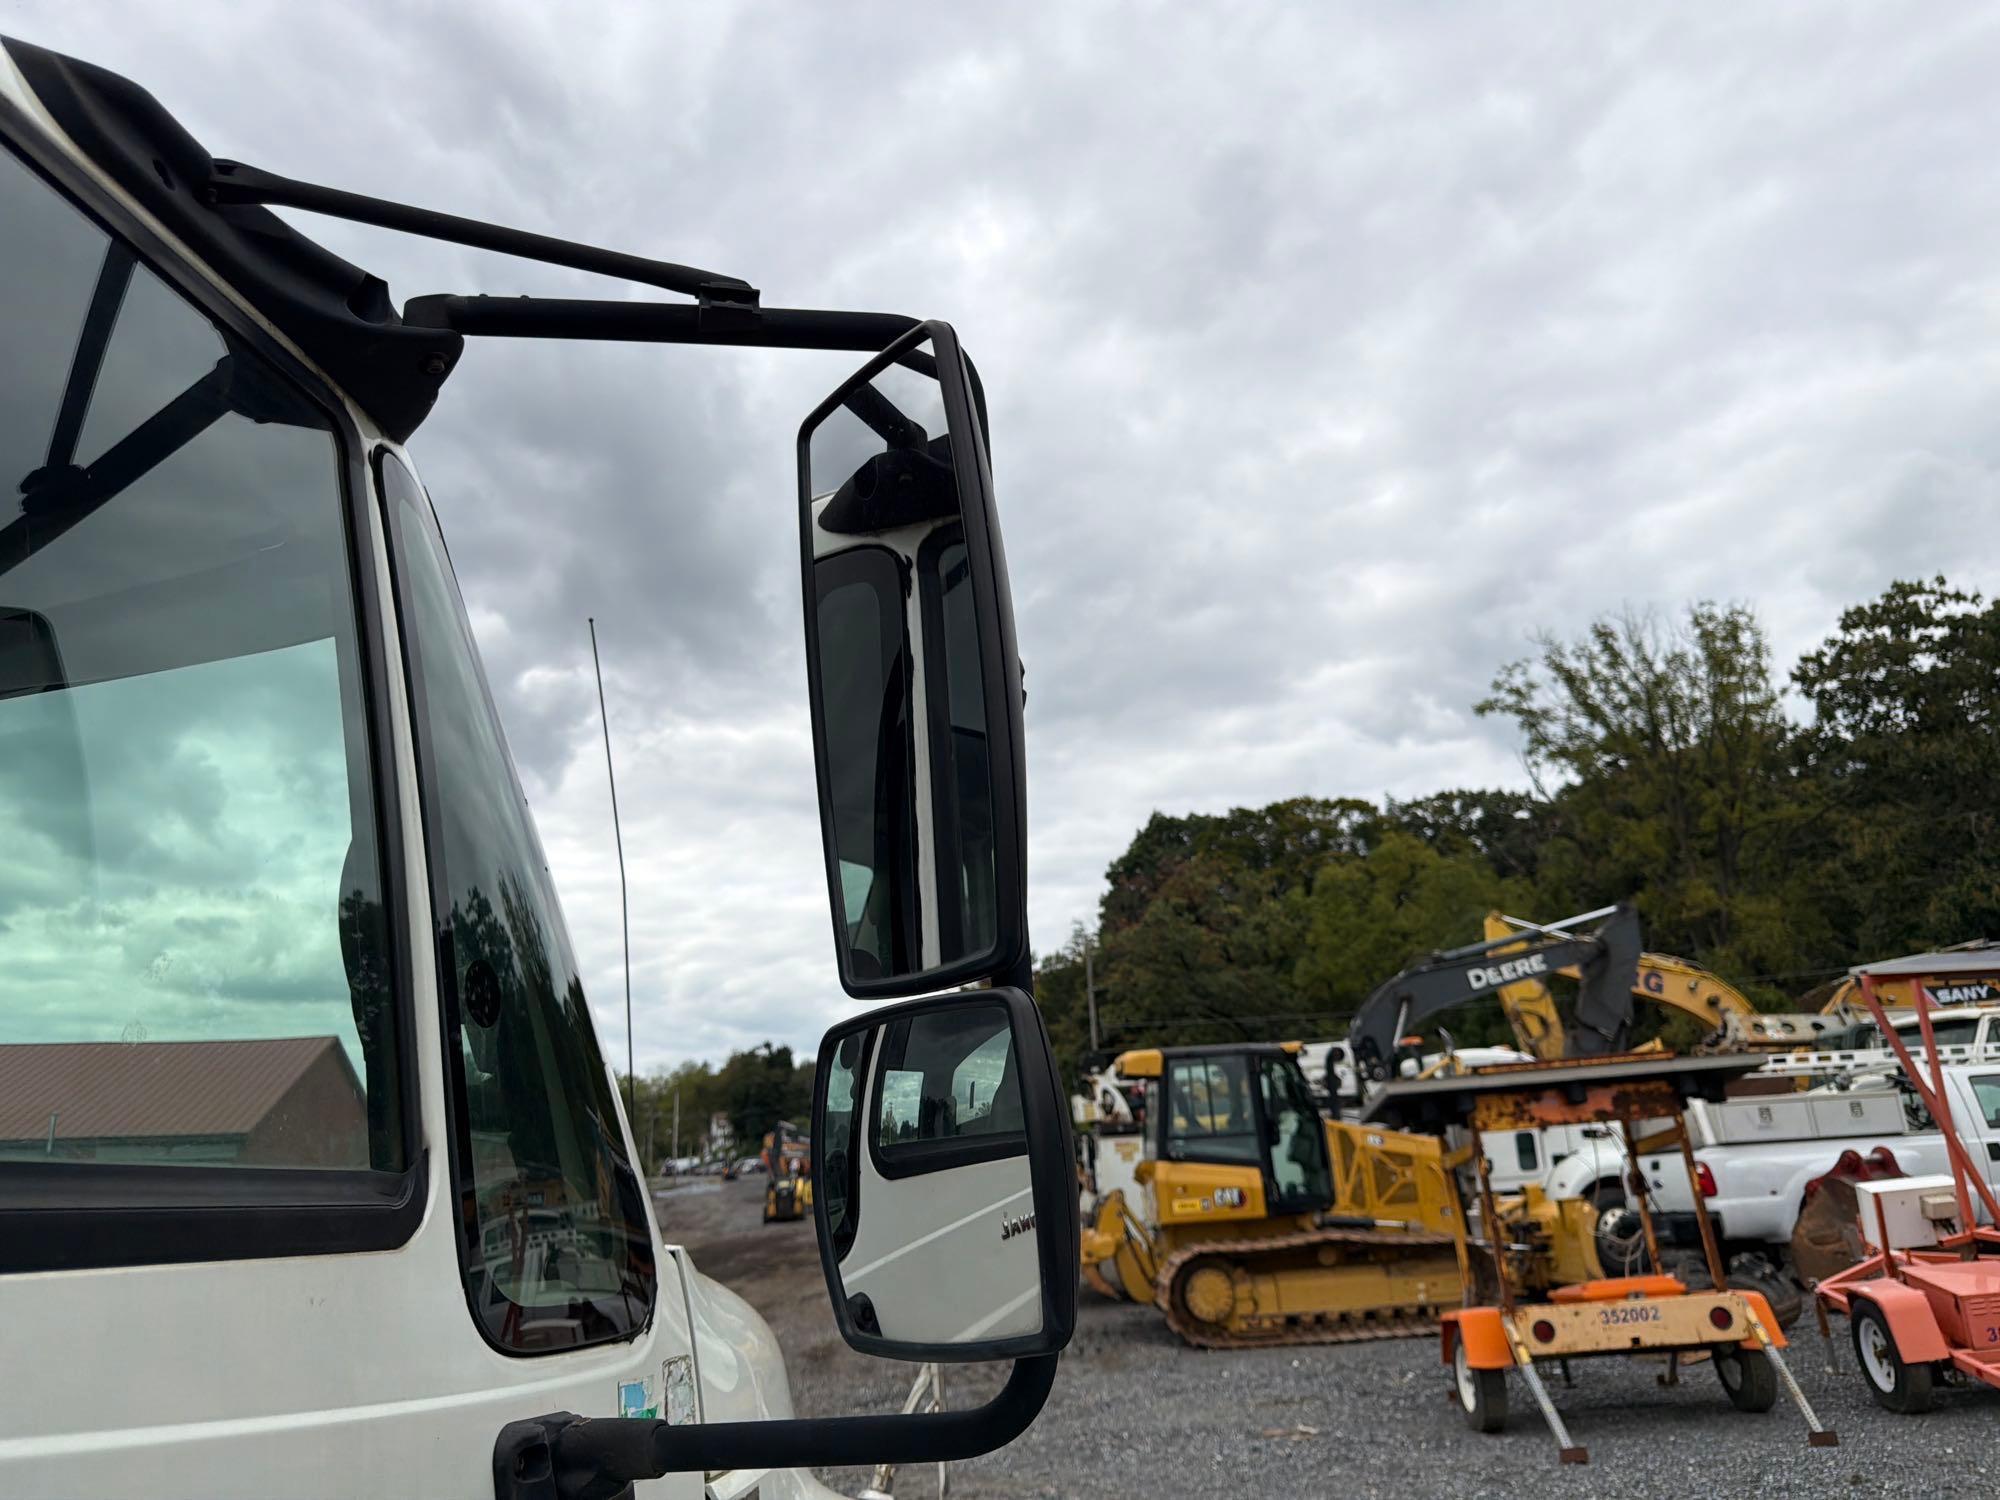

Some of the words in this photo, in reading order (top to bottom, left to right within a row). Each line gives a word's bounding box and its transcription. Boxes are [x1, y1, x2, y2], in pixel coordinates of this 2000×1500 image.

[1466, 953, 1548, 990] DEERE
[1936, 984, 1989, 1003] SANY
[1600, 1304, 1661, 1325] 352002
